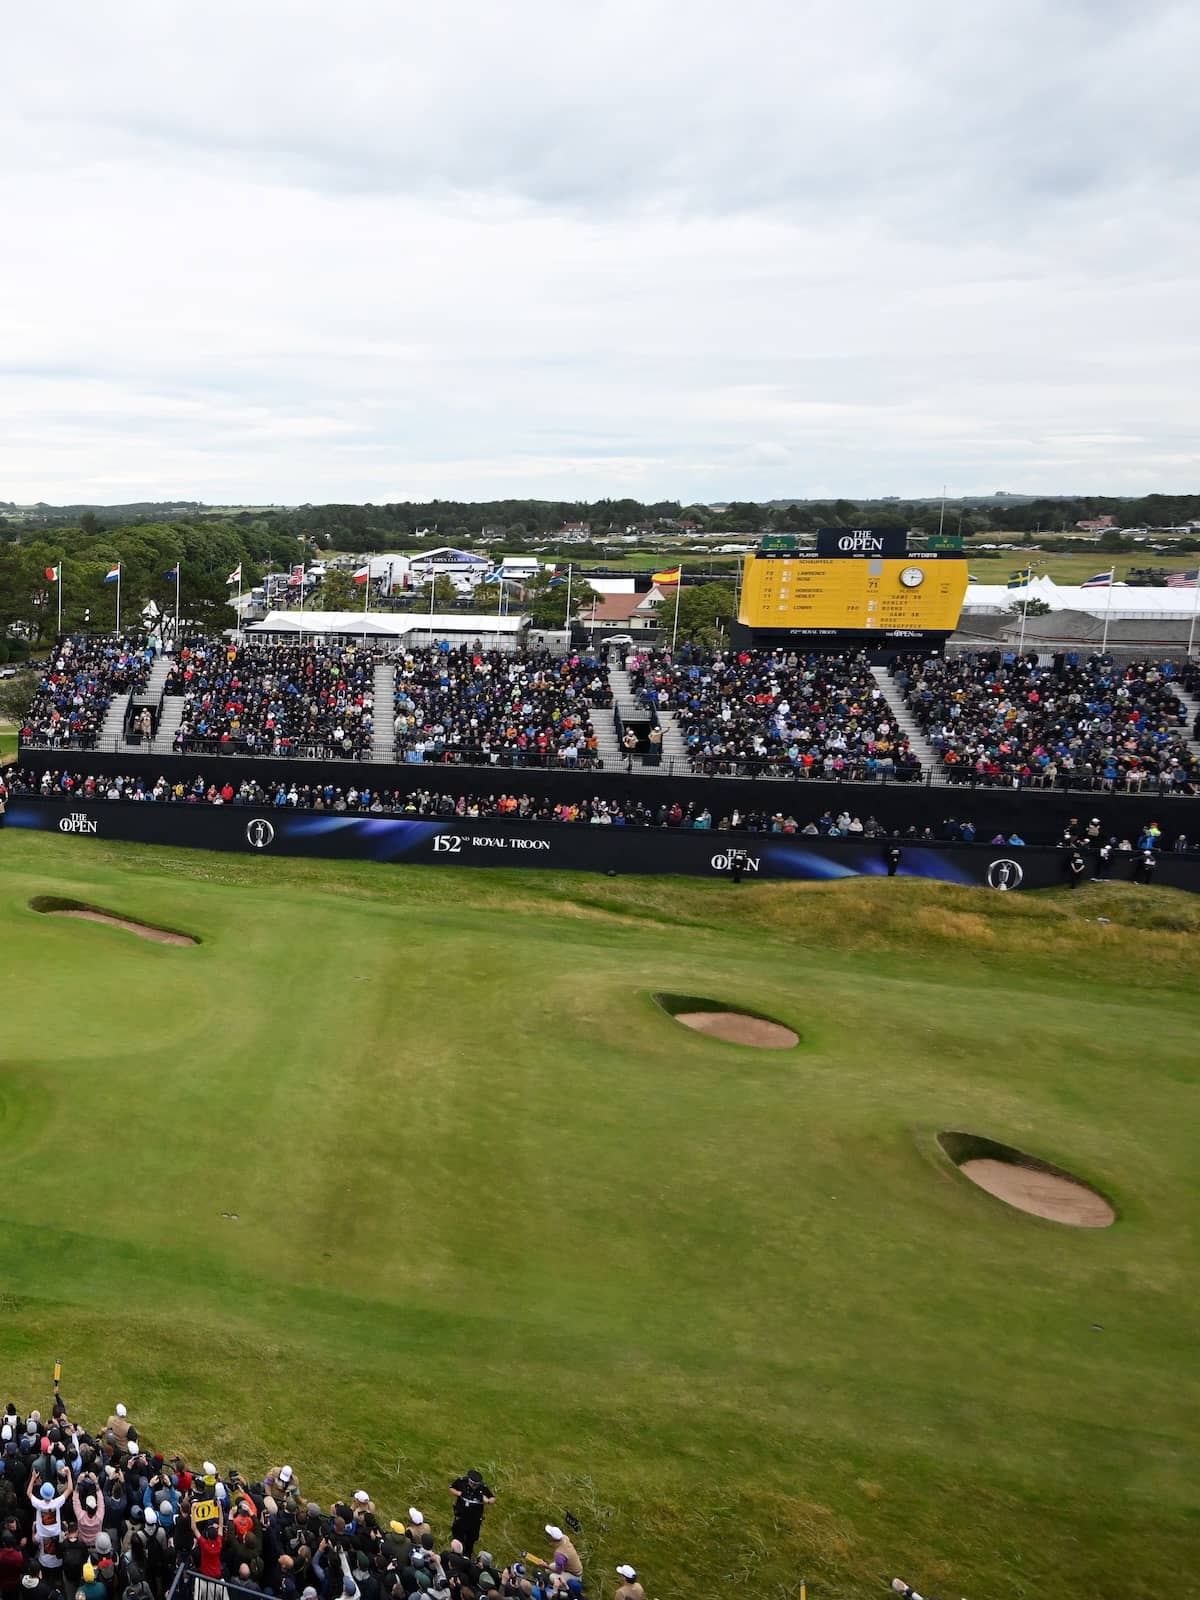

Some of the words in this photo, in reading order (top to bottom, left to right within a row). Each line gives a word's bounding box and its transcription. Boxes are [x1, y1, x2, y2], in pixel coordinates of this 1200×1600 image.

[852, 530, 872, 539] THE
[838, 535, 883, 550] OPEN
[70, 812, 87, 821] THE
[59, 817, 98, 833] OPEN
[472, 836, 508, 848] ROYAL
[509, 838, 550, 850] TROON
